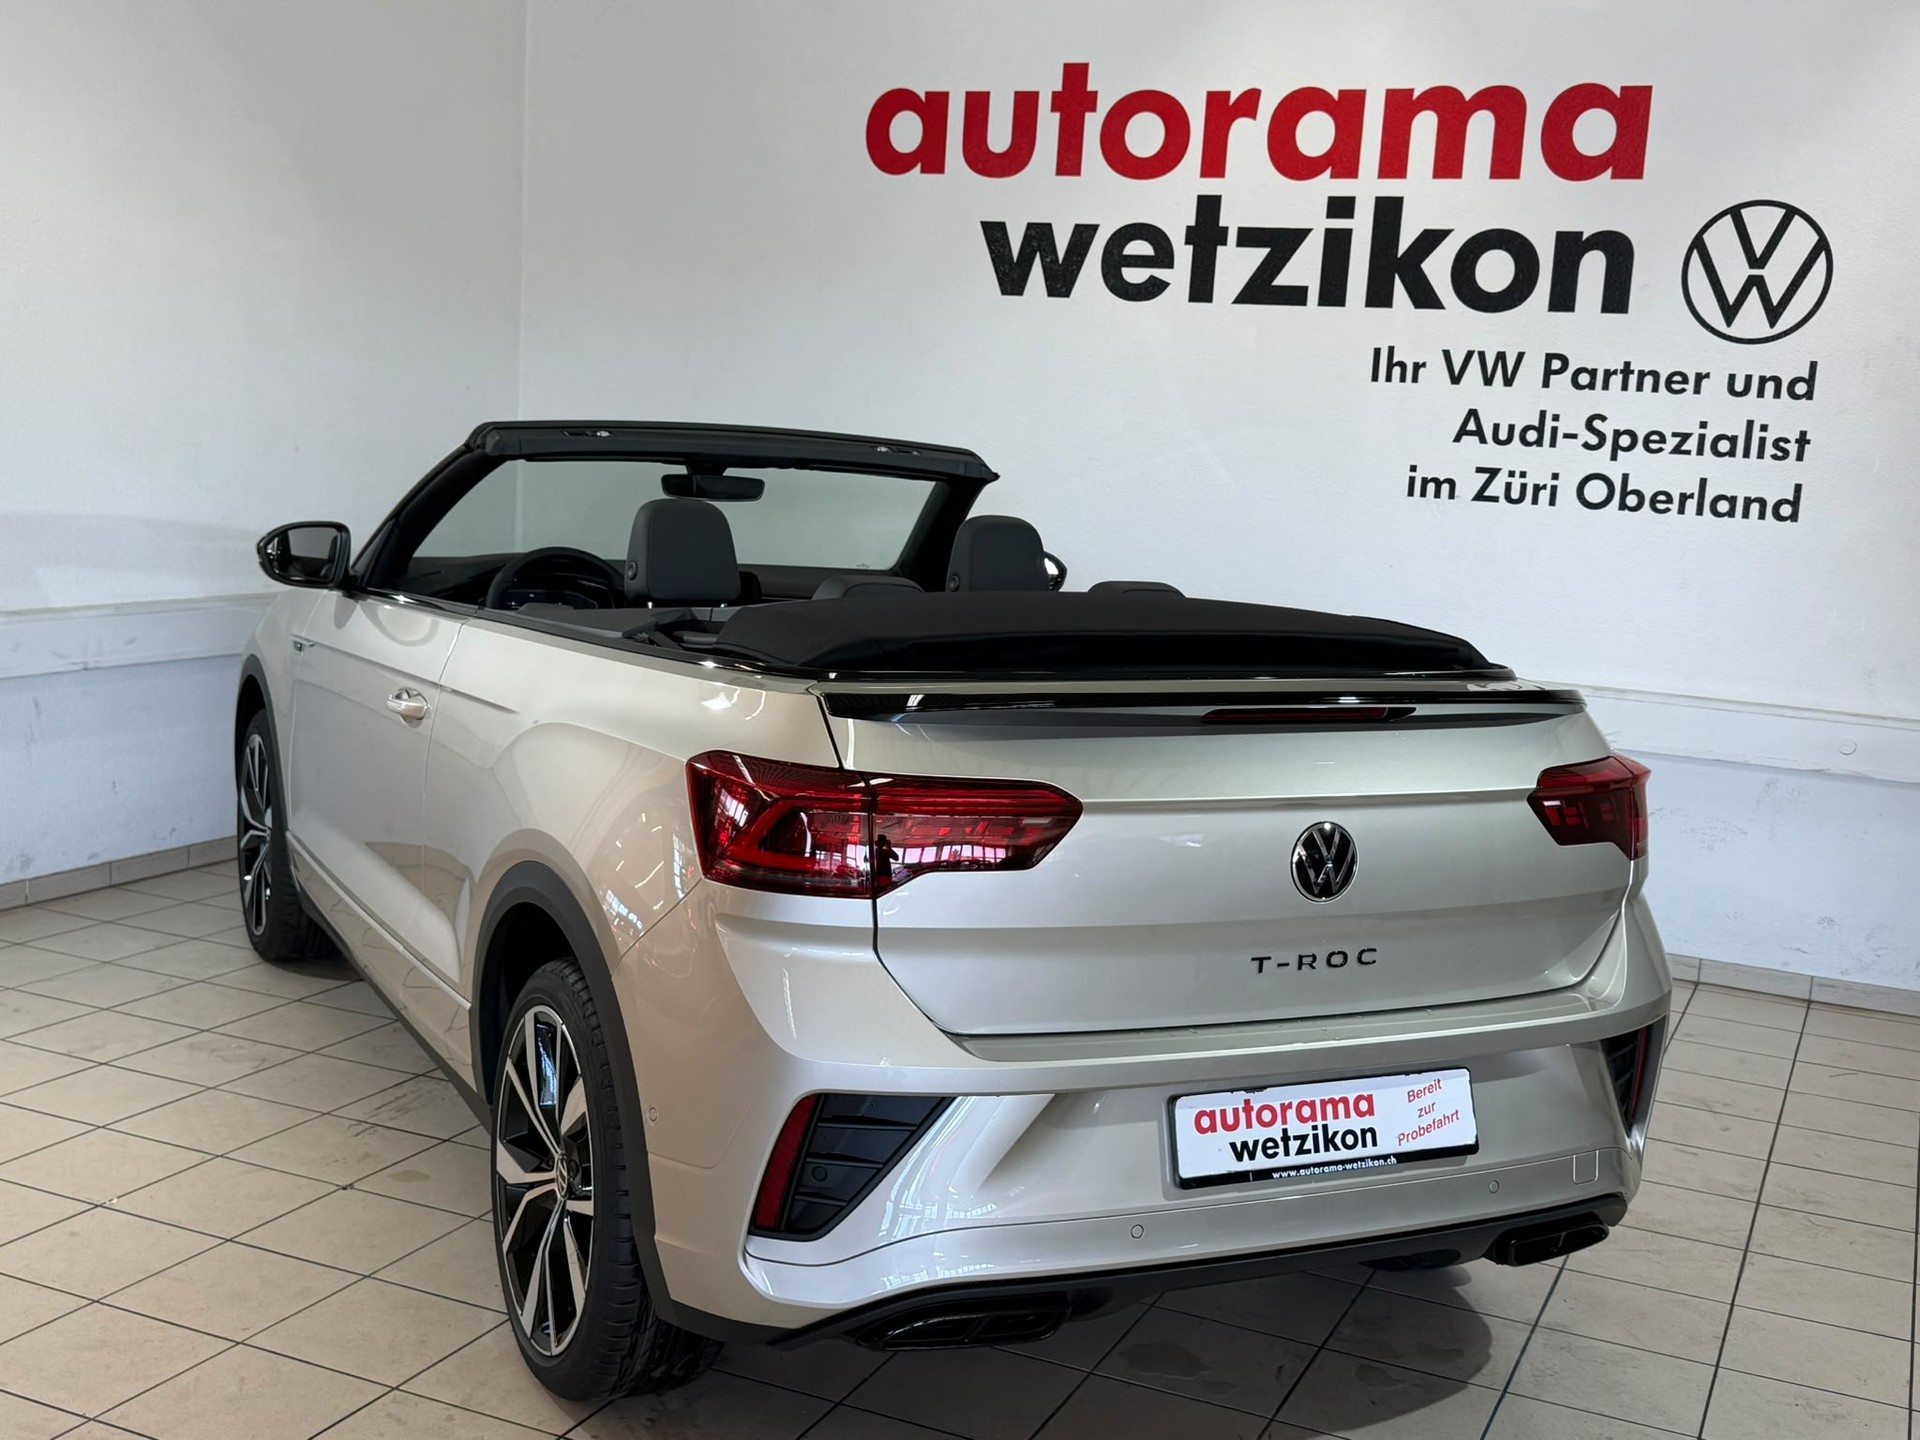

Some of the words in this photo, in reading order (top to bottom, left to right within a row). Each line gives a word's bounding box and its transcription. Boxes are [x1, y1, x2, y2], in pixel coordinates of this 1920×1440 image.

[866, 62, 1653, 181] autorama
[980, 195, 1635, 314] wetzikon
[1370, 345, 1427, 384] Ihr
[1442, 349, 1526, 388] VW
[1541, 352, 1711, 395] Partner
[1726, 360, 1818, 401] und
[1453, 408, 1811, 462] Audi-Spezialist
[1407, 464, 1457, 500] im
[1471, 467, 1560, 507] Züri
[1576, 472, 1803, 523] Oberland
[1250, 947, 1378, 974] T-ROC
[1406, 1078, 1442, 1103] Bereit
[1417, 1101, 1436, 1118] zur
[1194, 1094, 1376, 1136] autorama
[1397, 1108, 1460, 1146] Probefahrt
[1228, 1124, 1379, 1163] wetzikon
[1272, 1155, 1398, 1179] www.autorama-wetzikon.ch
